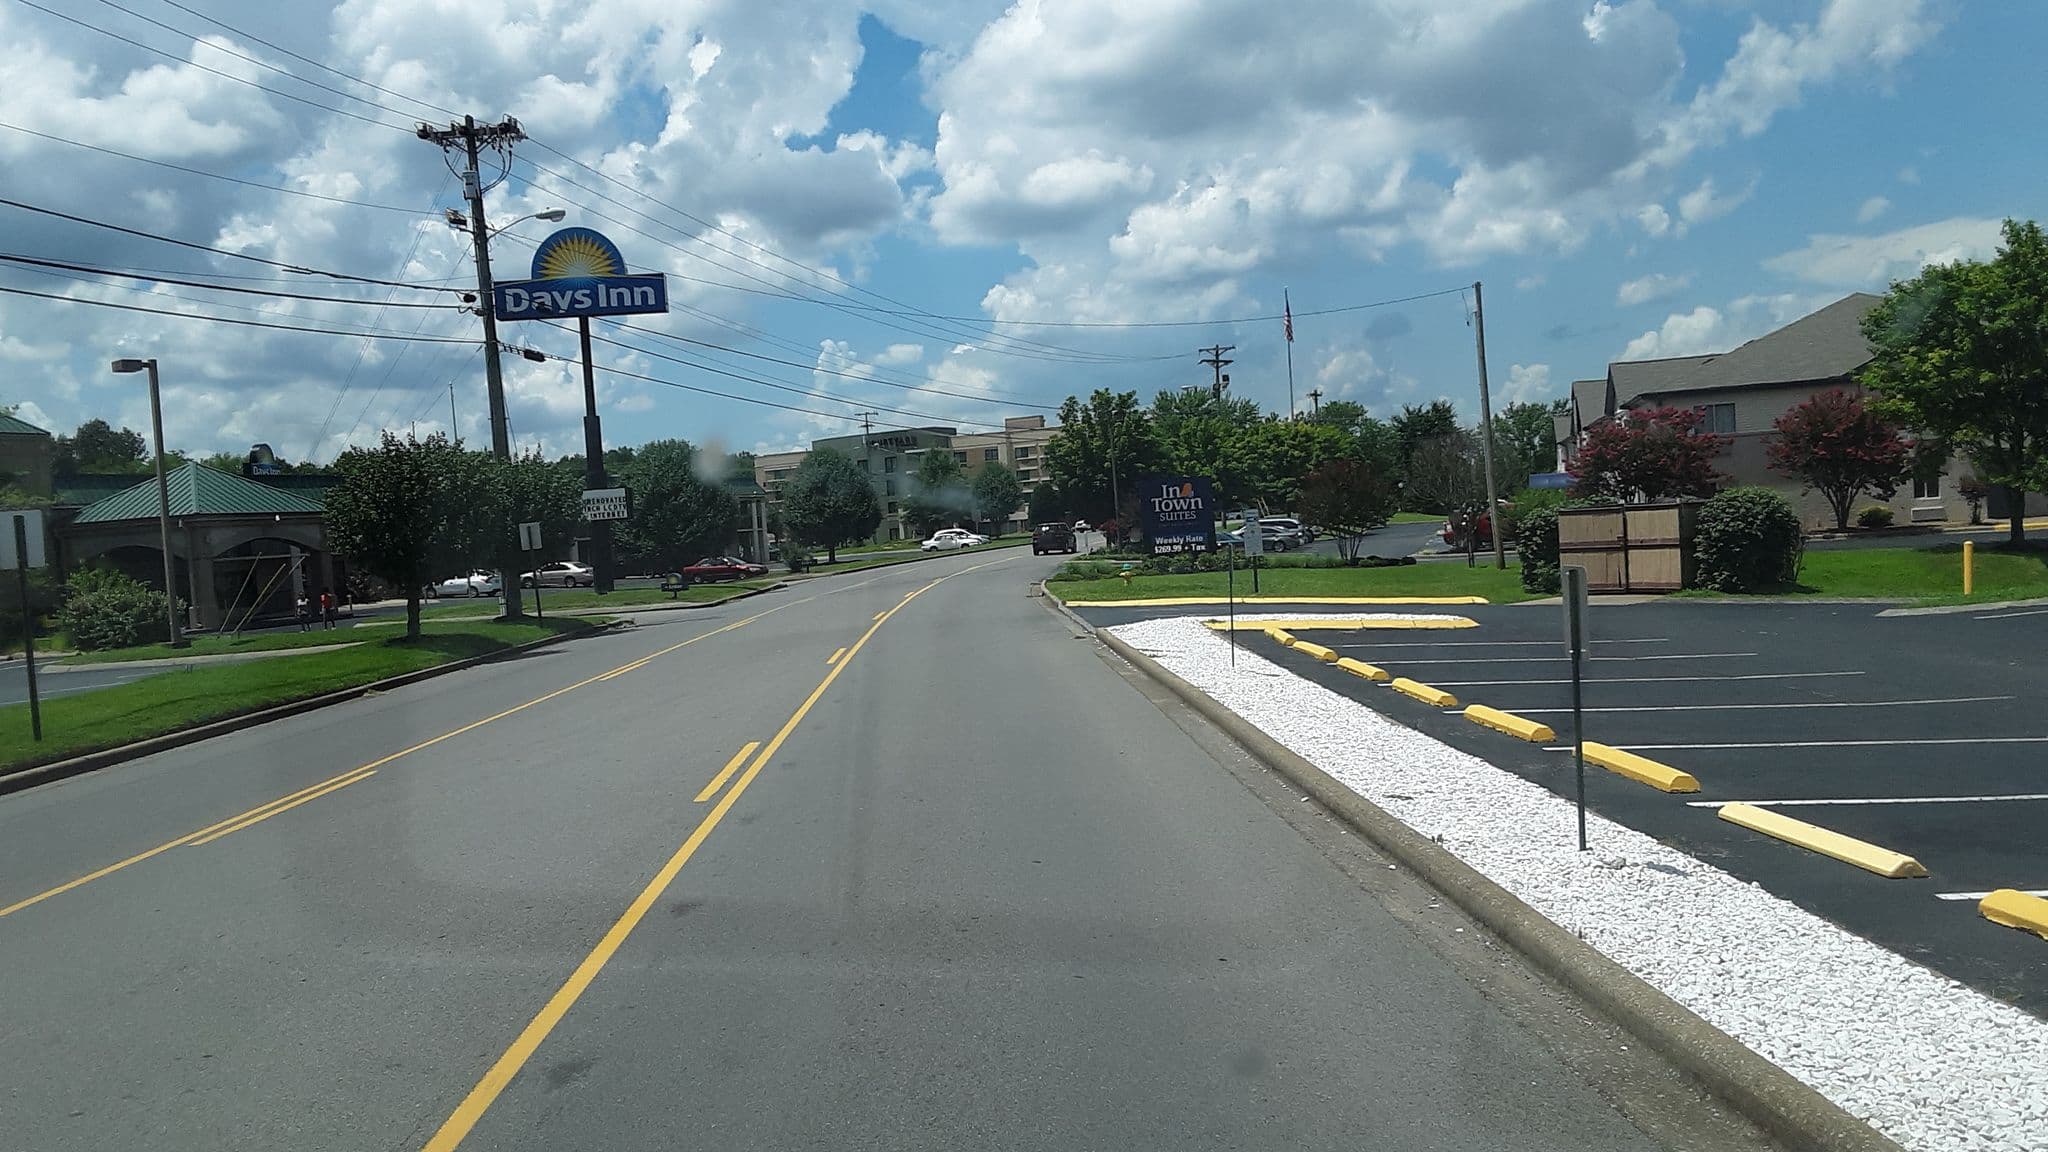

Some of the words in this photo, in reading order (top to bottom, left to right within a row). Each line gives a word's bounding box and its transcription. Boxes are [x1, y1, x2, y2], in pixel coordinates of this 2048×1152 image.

[505, 288, 592, 313] Days
[597, 284, 656, 308] Inn
[1161, 484, 1180, 499] In
[1151, 497, 1204, 512] Town
[590, 511, 625, 519] INTERNET
[1160, 511, 1197, 522] SUITES
[1154, 535, 1184, 545] Weekly
[1185, 534, 1204, 543] Rate
[1191, 543, 1206, 551] Tax
